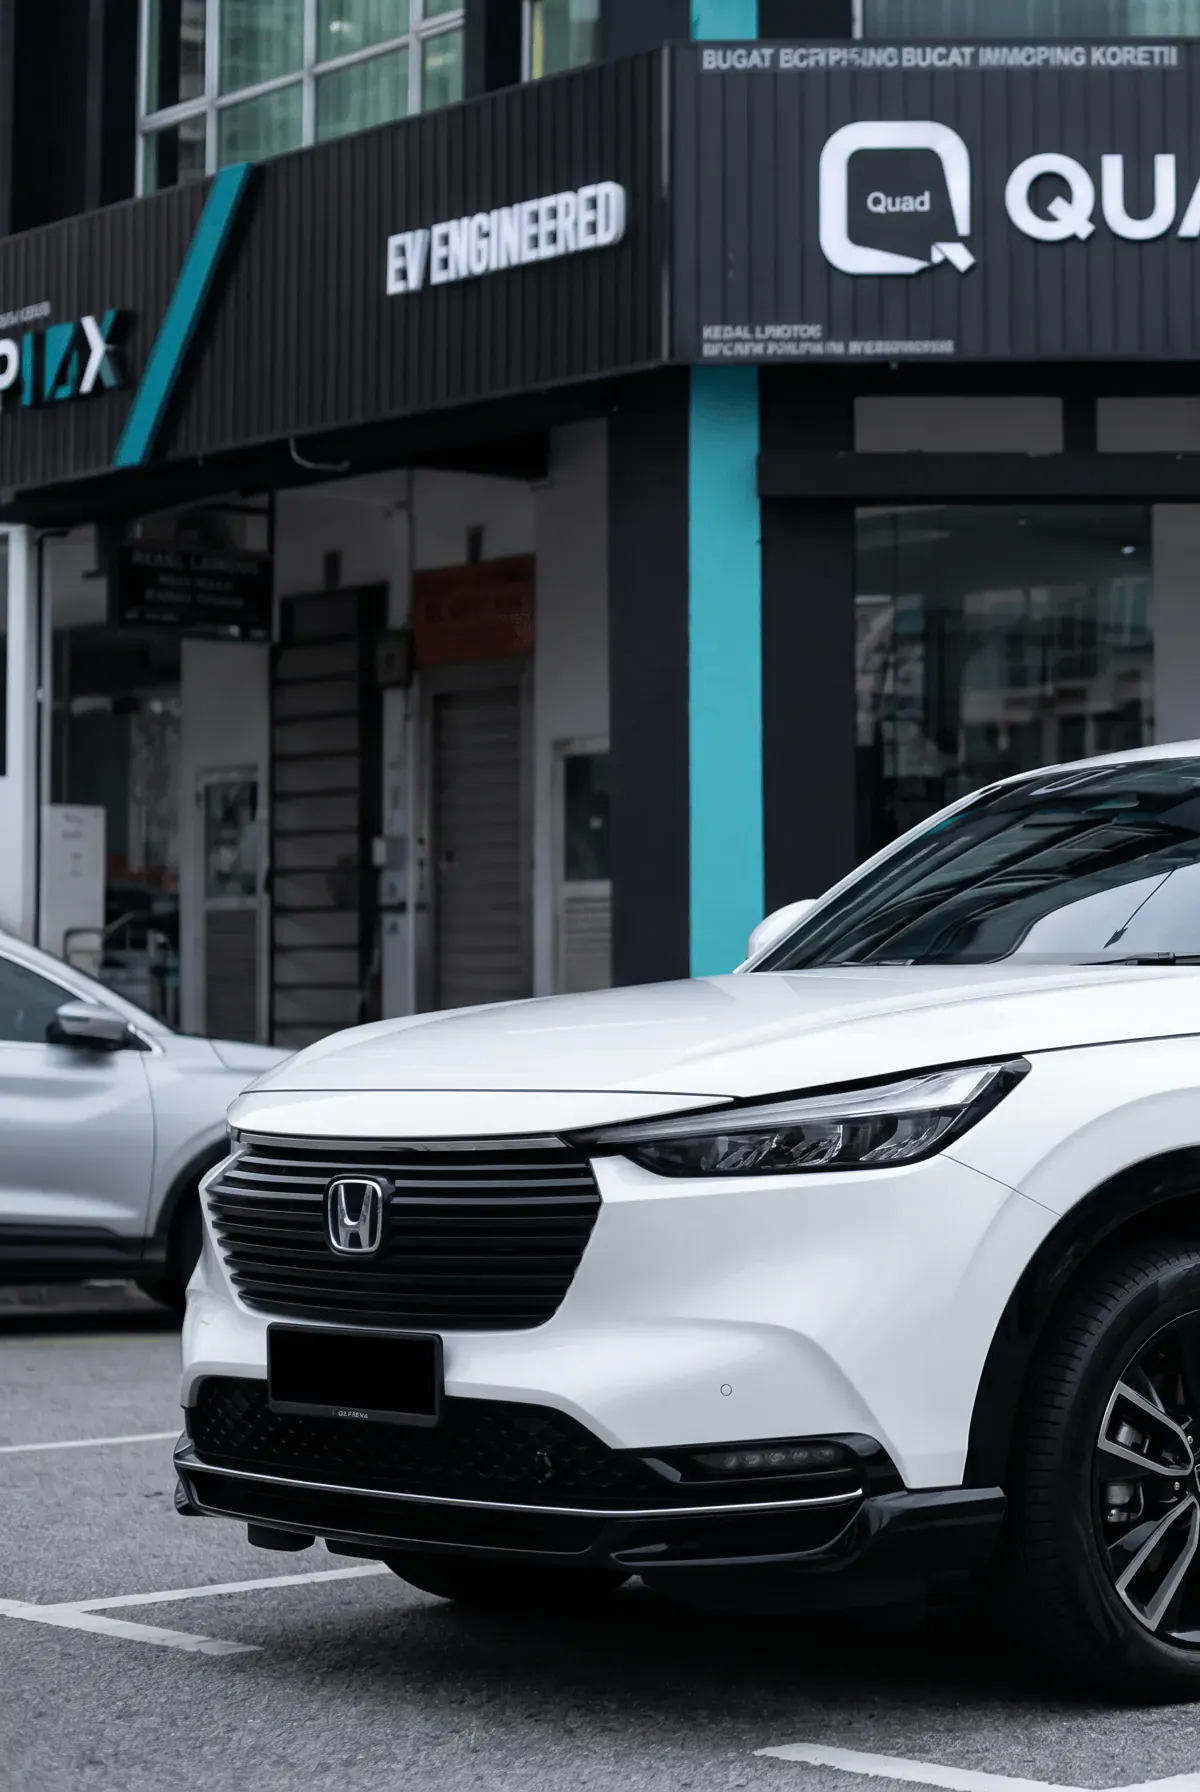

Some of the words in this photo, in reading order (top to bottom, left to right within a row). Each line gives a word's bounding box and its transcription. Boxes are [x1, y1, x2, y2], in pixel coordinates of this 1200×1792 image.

[866, 190, 931, 214] Quad
[387, 228, 430, 296] EV
[430, 181, 626, 285] ENGINEERED
